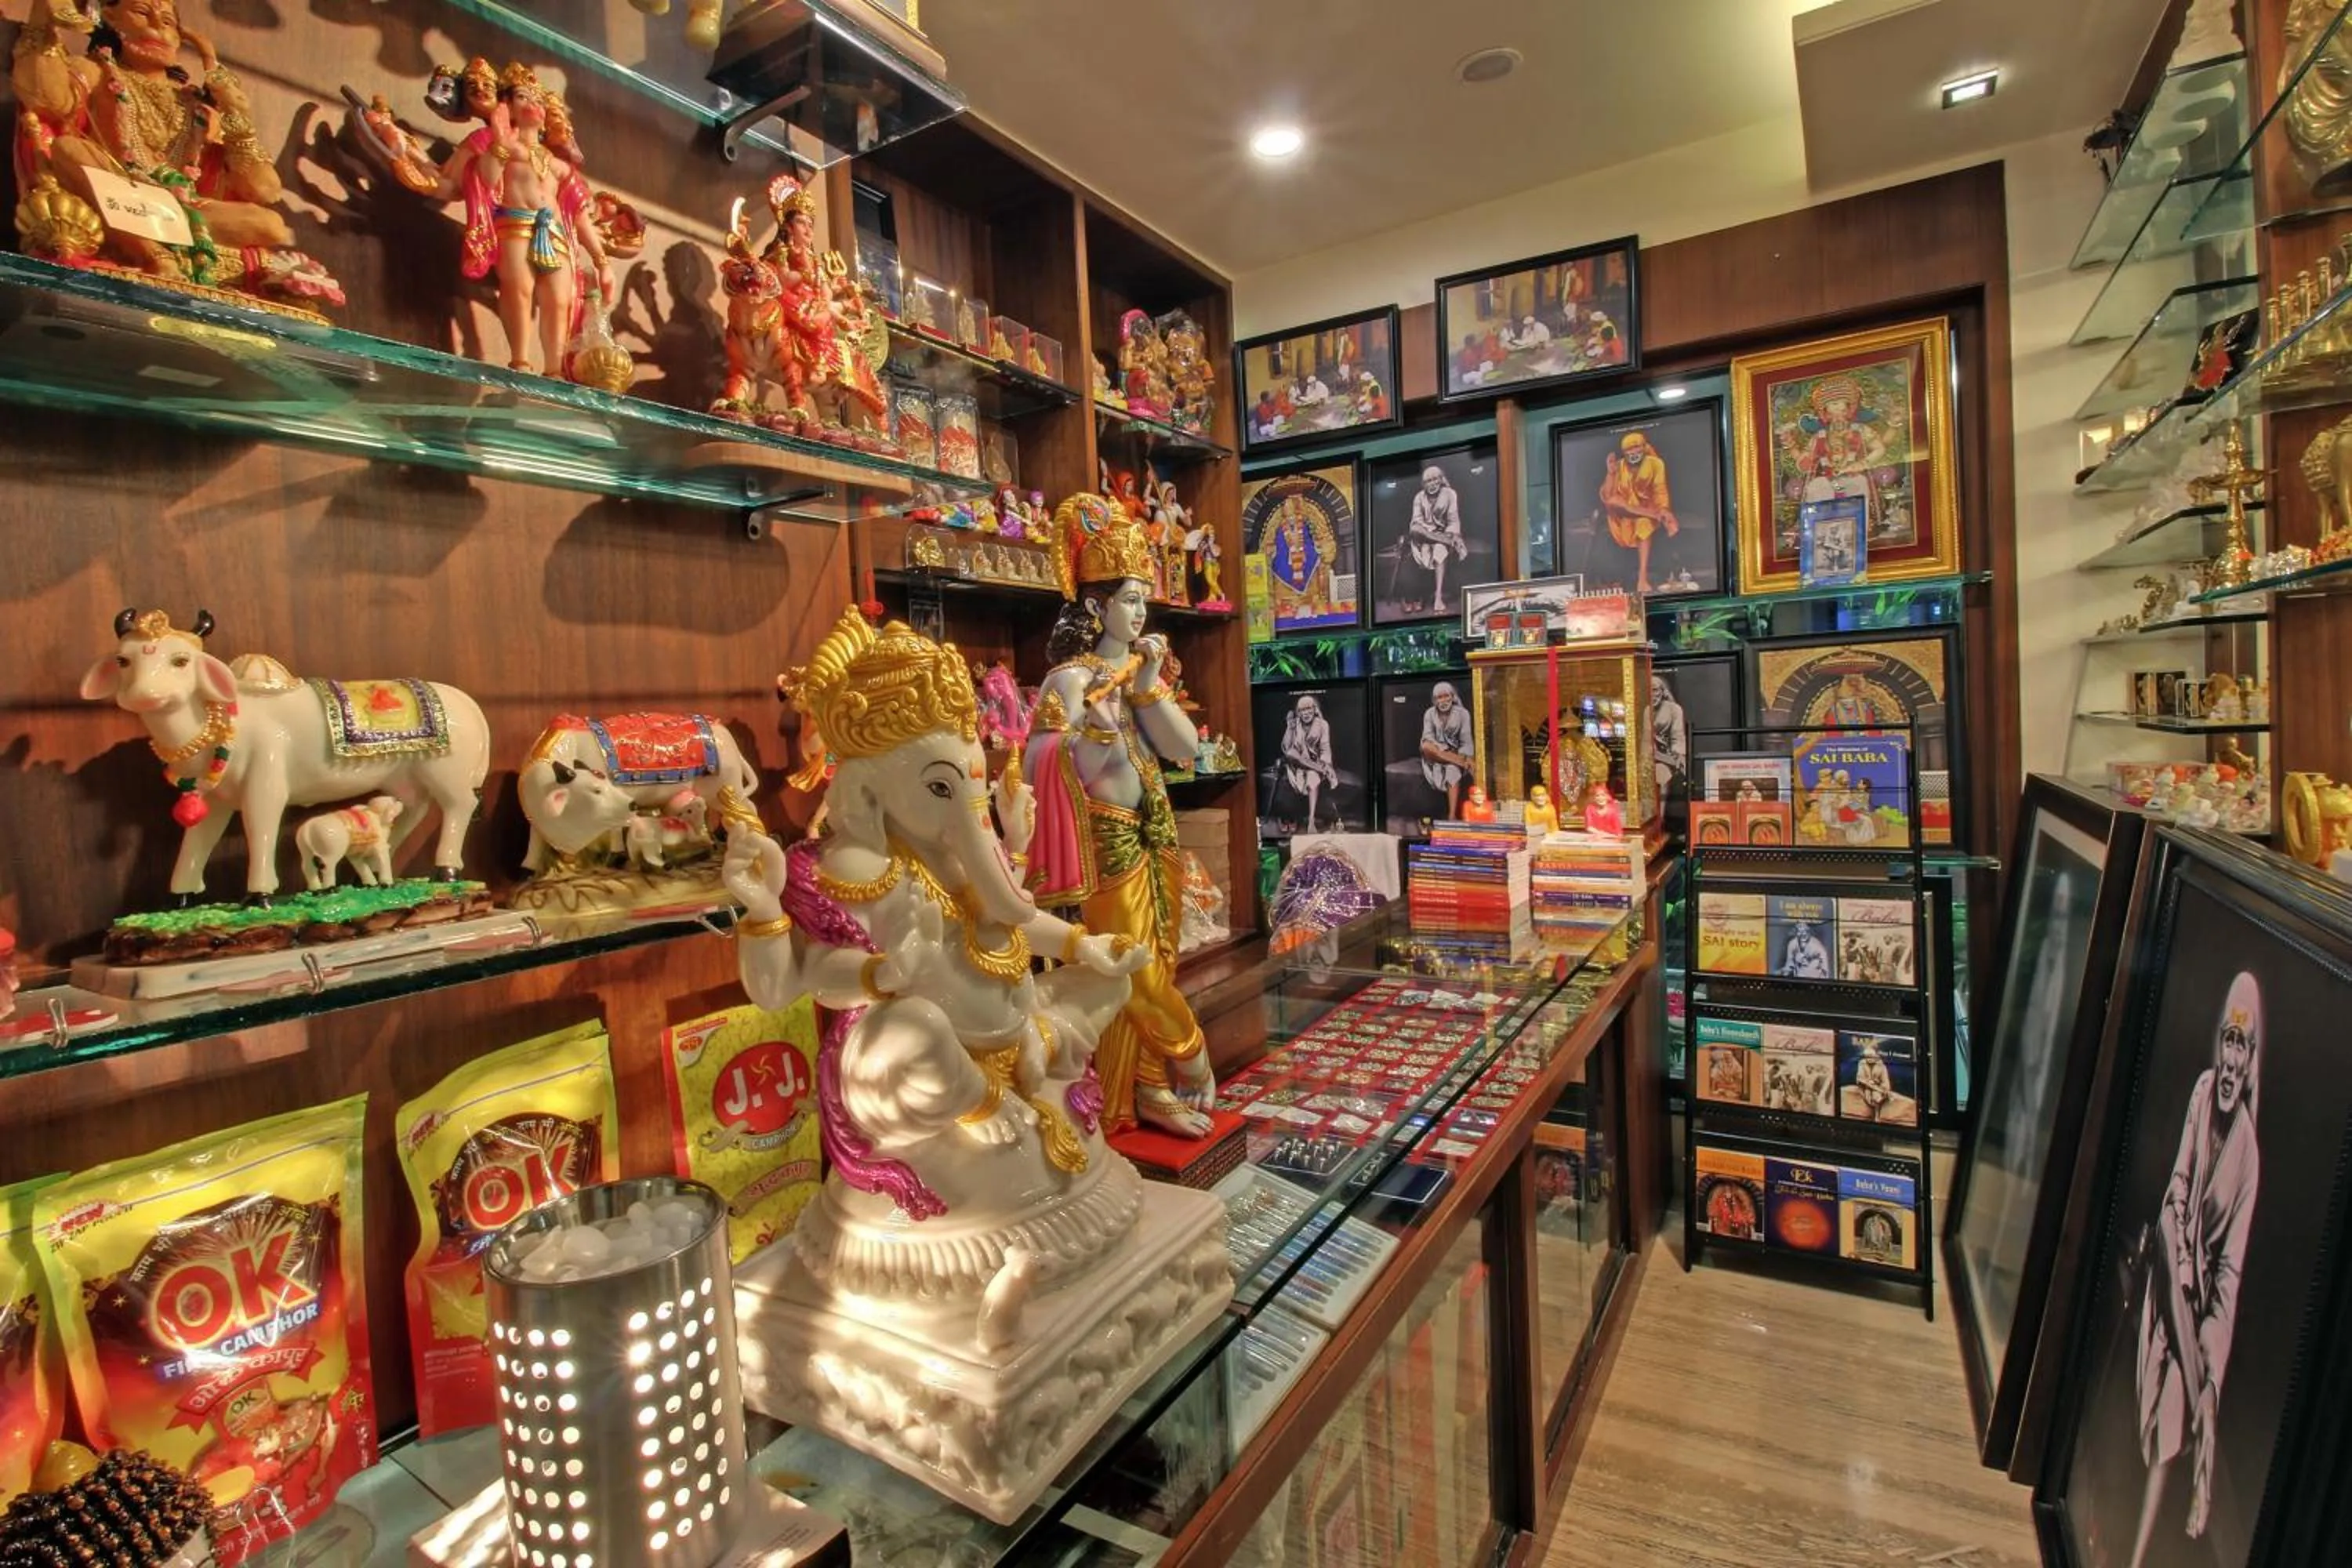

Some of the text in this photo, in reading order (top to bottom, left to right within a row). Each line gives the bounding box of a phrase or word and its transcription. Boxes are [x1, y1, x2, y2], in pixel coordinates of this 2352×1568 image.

[1809, 752, 1888, 764] SAI BABA
[1702, 935, 1760, 950] SAI story
[463, 1134, 581, 1231] OK
[152, 1229, 318, 1352] OK
[220, 1302, 319, 1356] CAMPHOR
[231, 1390, 257, 1416] OK
